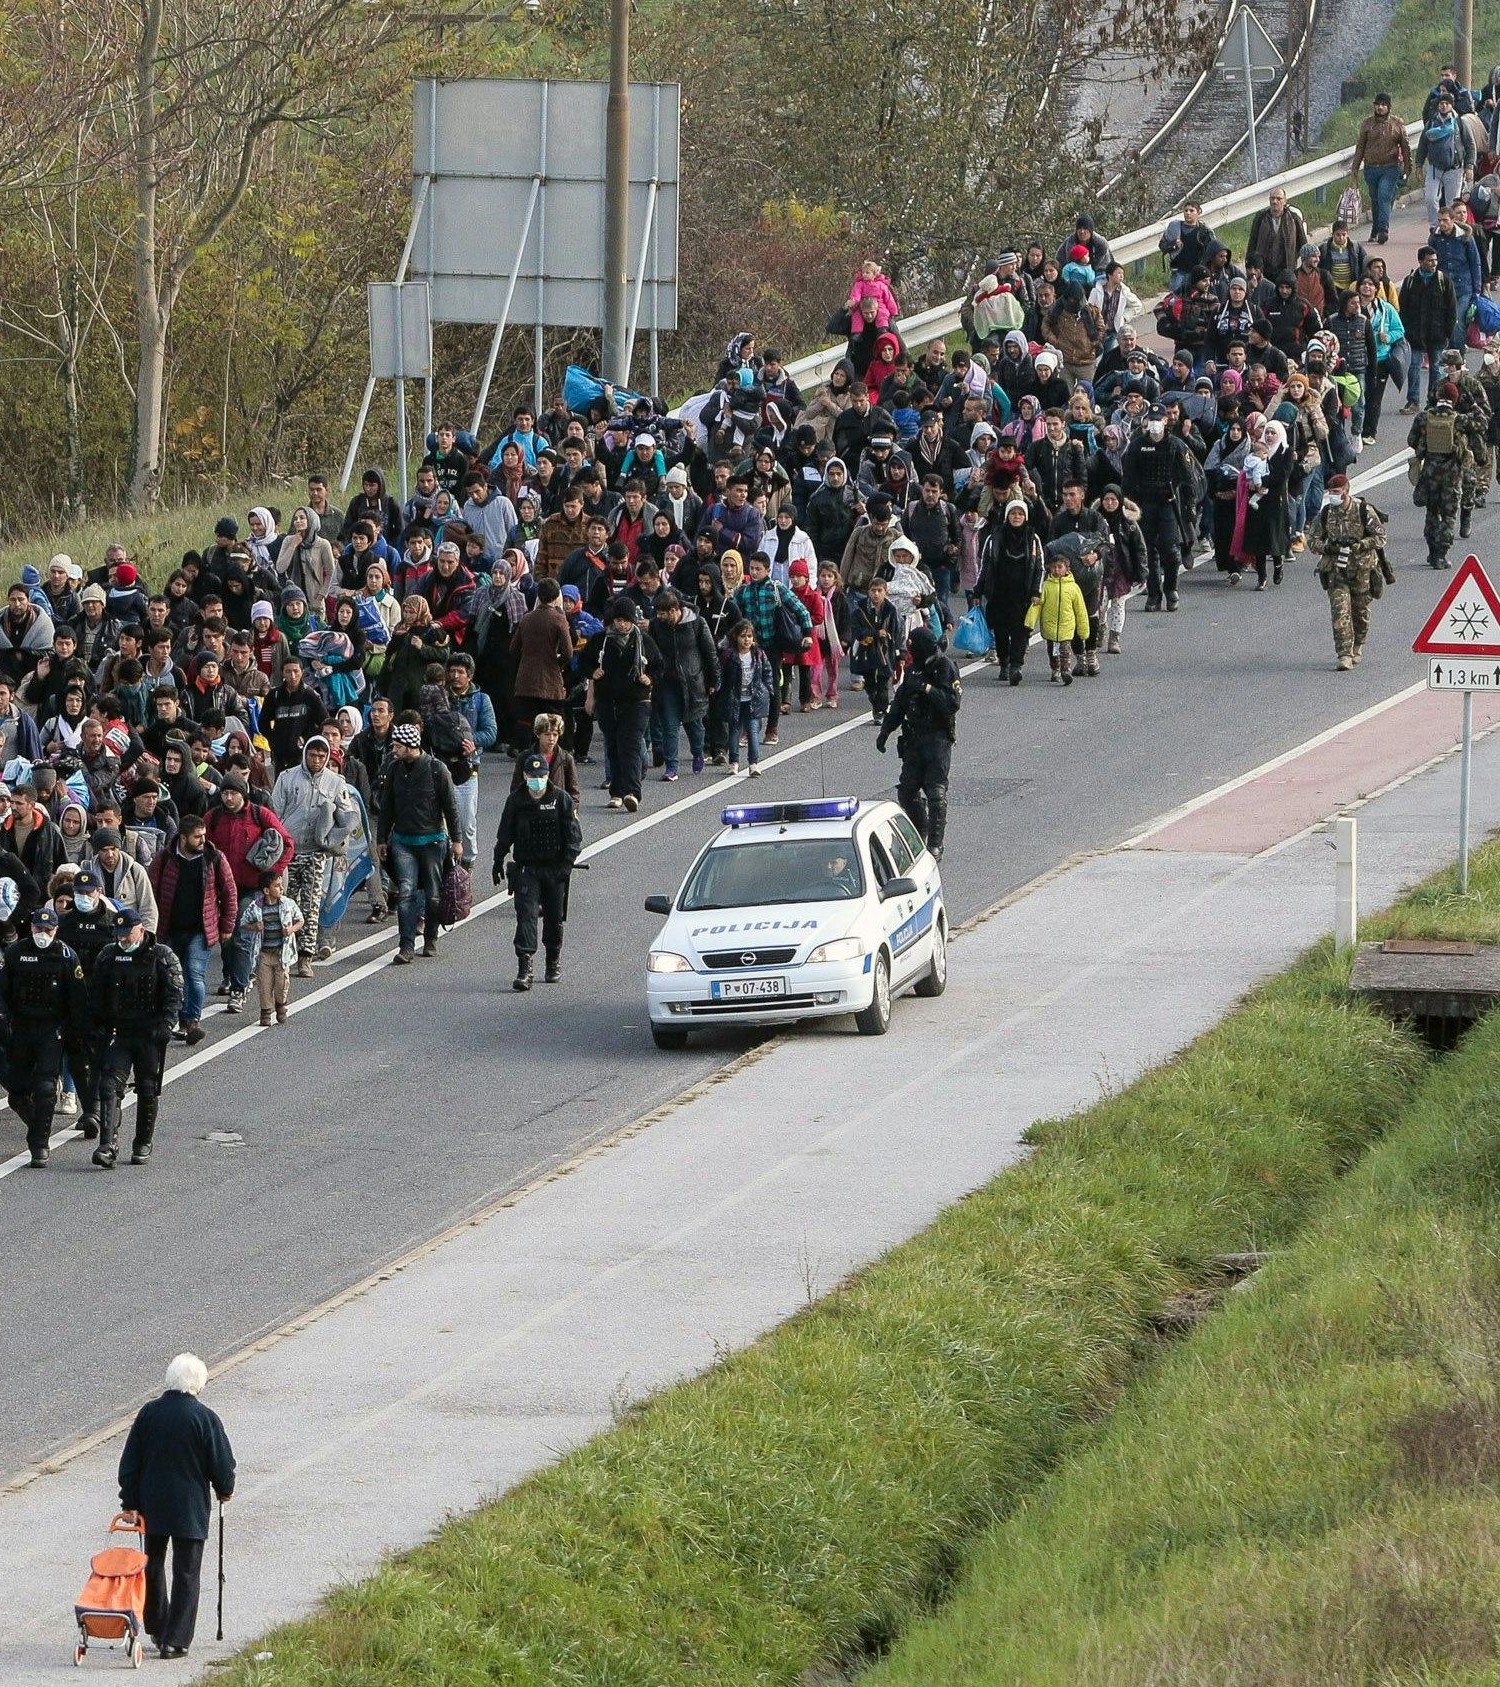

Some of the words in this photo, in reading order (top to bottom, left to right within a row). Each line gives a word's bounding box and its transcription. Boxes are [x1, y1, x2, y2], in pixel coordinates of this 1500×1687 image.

[1448, 669, 1466, 686] 1,3
[1470, 670, 1489, 685] km
[691, 920, 818, 937] POLICIJA
[724, 984, 732, 995] P
[742, 981, 780, 994] 07-438
